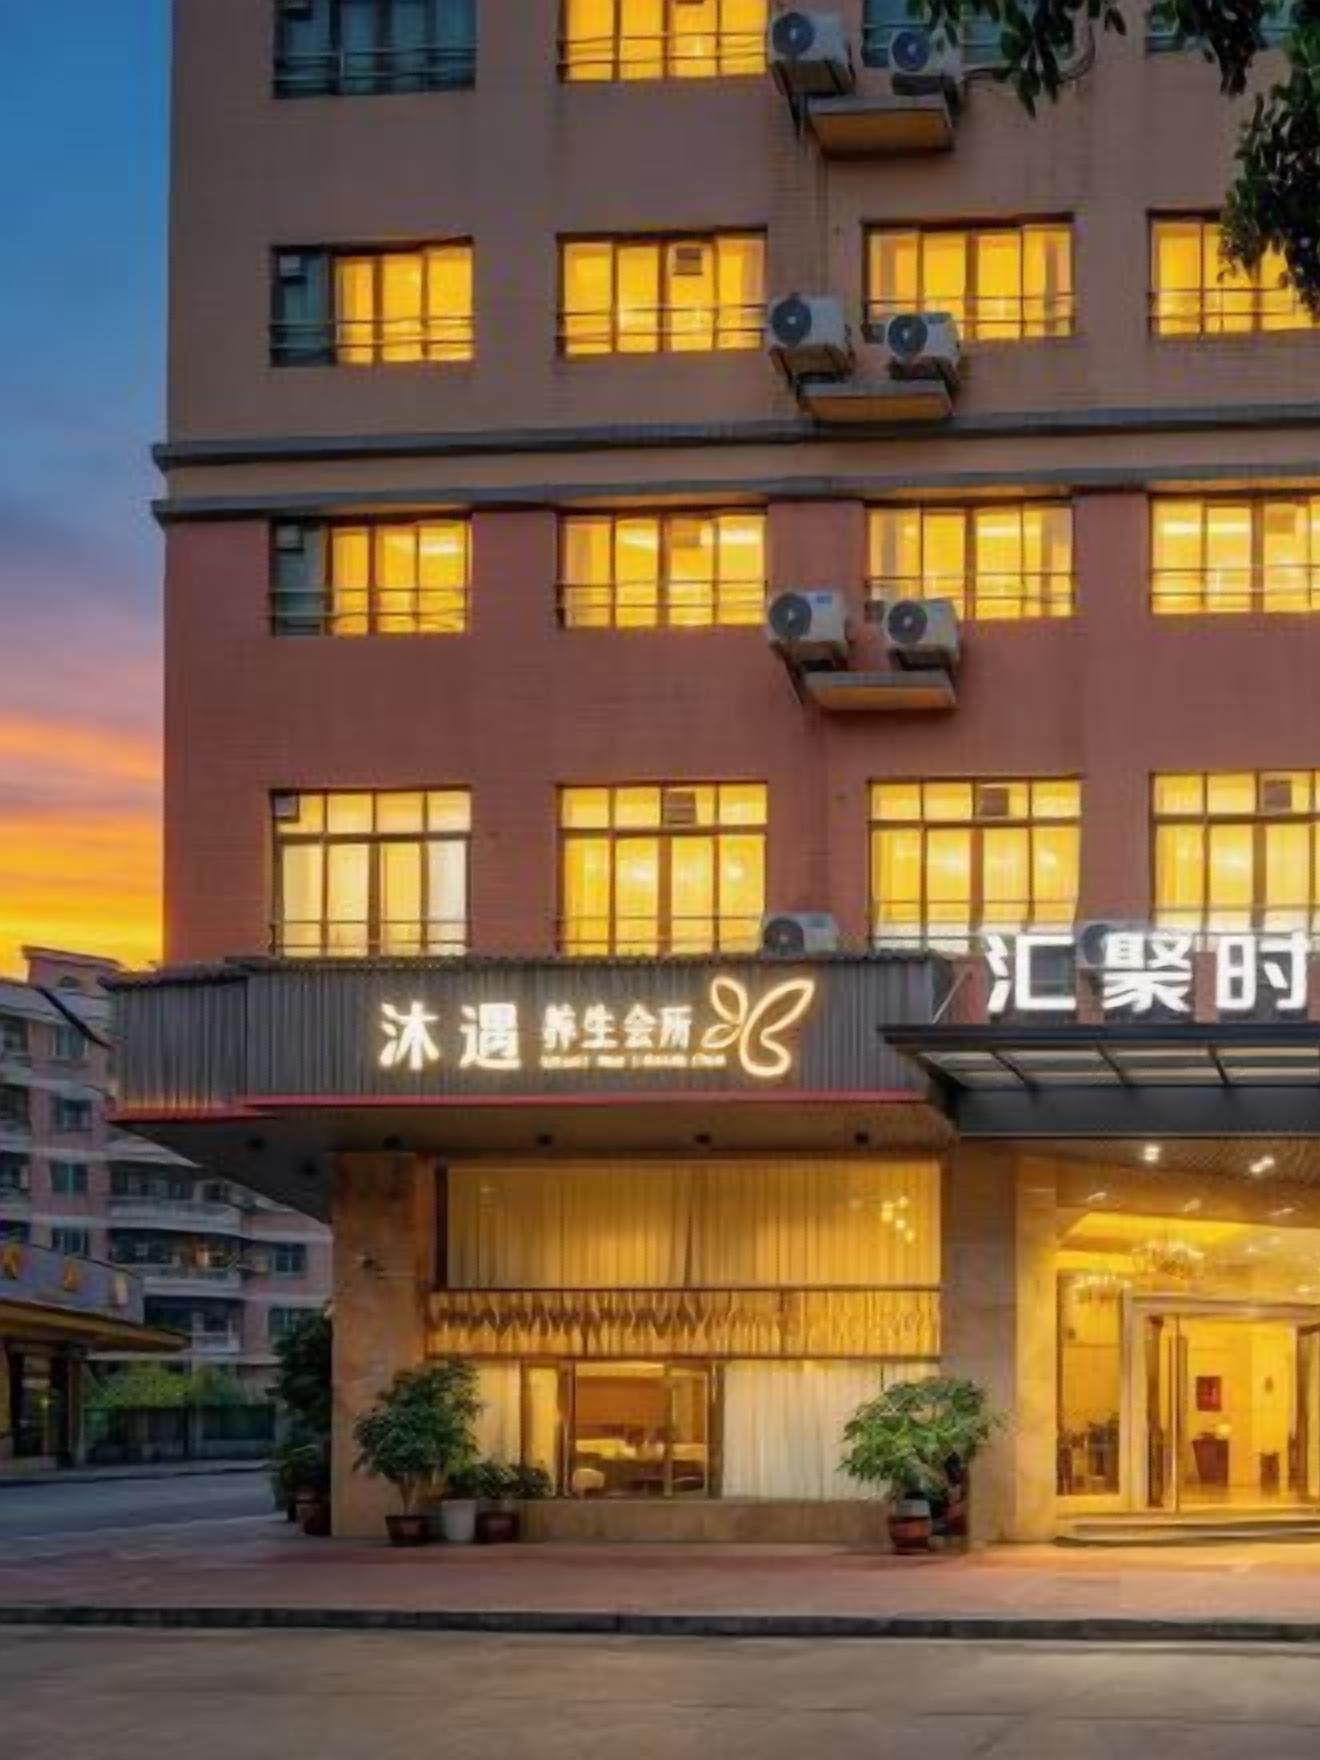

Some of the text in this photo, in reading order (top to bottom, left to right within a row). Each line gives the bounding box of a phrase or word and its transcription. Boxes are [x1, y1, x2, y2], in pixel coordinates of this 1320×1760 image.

[378, 1000, 694, 1070] 沐遇 养生会所
